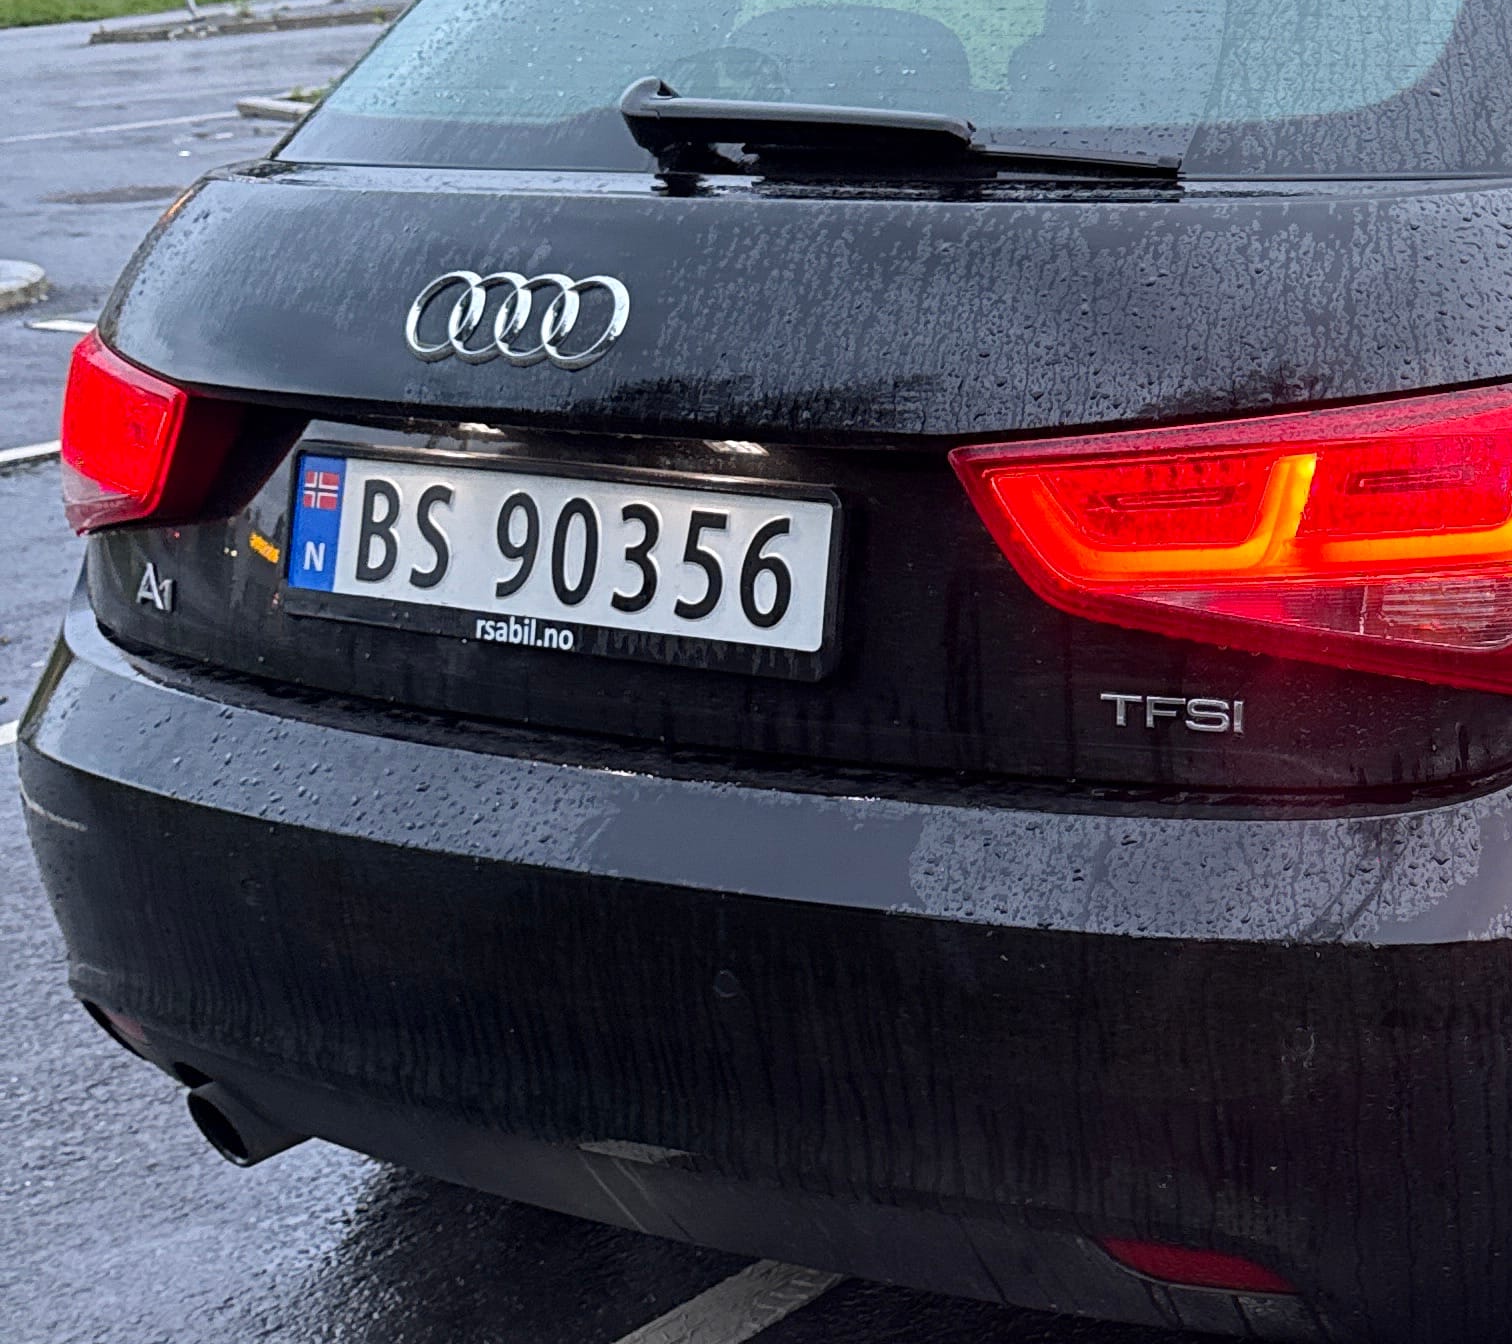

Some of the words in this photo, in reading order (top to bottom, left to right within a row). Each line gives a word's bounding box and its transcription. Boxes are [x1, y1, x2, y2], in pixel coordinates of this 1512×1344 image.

[303, 541, 326, 572] N
[355, 478, 454, 589] BS
[495, 490, 792, 629] 90356
[136, 562, 173, 613] A1
[475, 616, 575, 651] rsabil.no
[1100, 693, 1244, 734] TFSI
